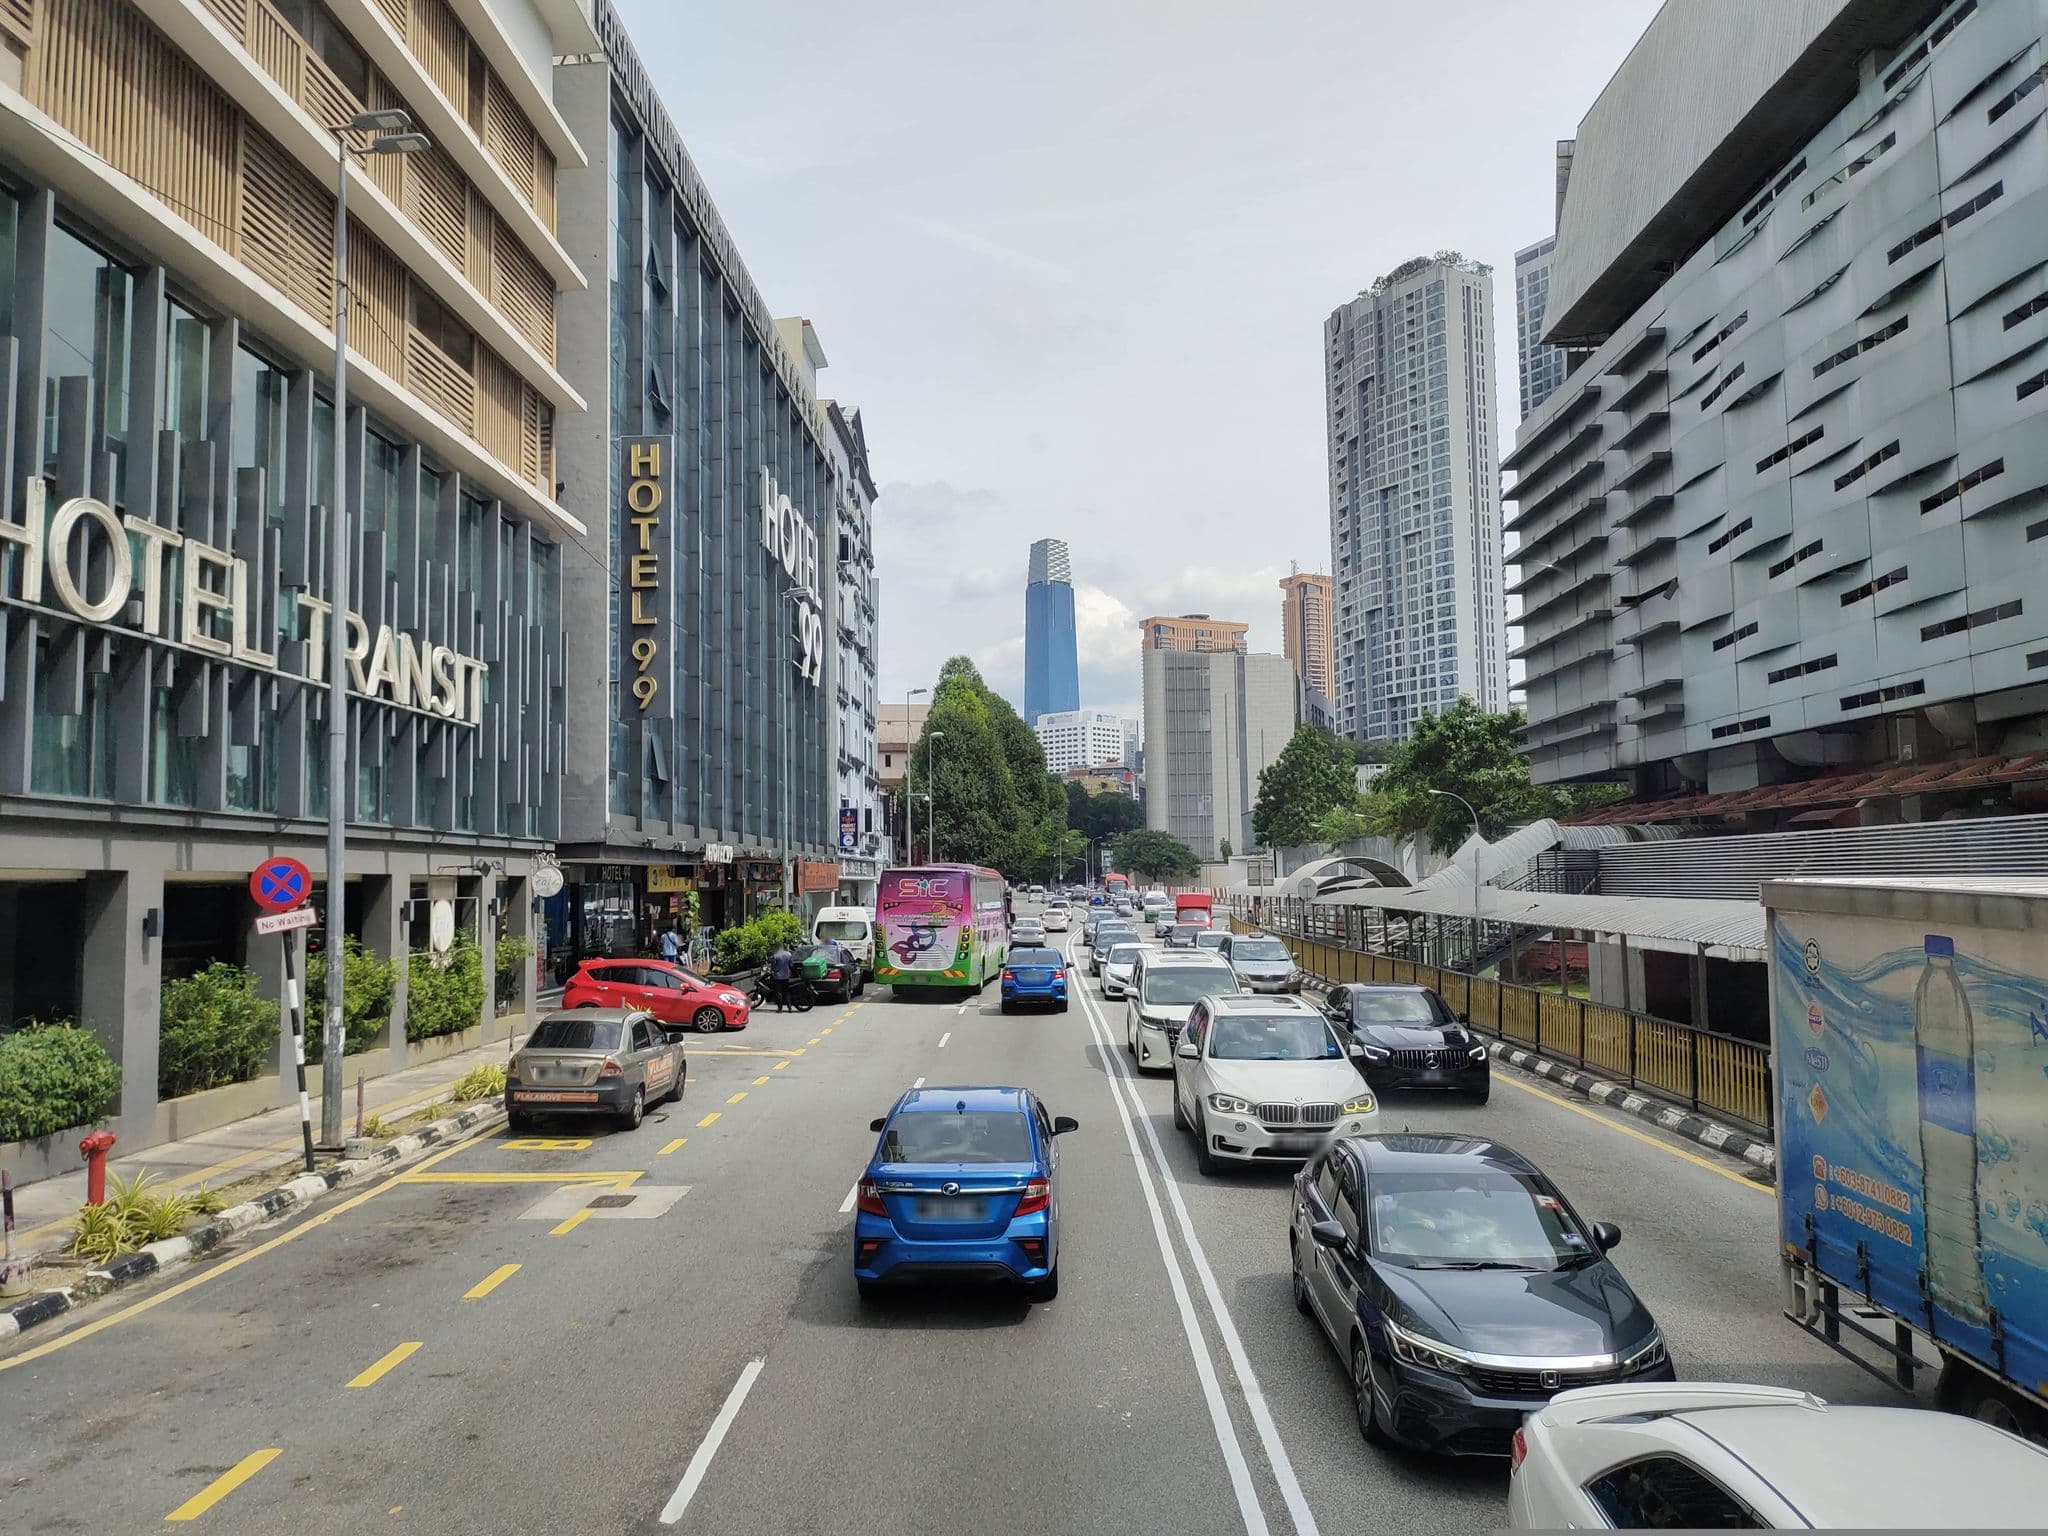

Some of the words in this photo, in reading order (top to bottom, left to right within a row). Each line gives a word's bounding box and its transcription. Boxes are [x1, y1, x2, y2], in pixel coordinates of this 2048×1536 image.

[628, 443, 662, 625] HOTEL
[760, 465, 822, 610] HOTEL
[799, 601, 822, 687] 99
[297, 589, 489, 725] TRANSIT
[632, 638, 657, 710] 99
[602, 866, 622, 880] HOTEL
[1884, 1184, 1910, 1214] 0882
[1885, 1216, 1912, 1247] 0882
